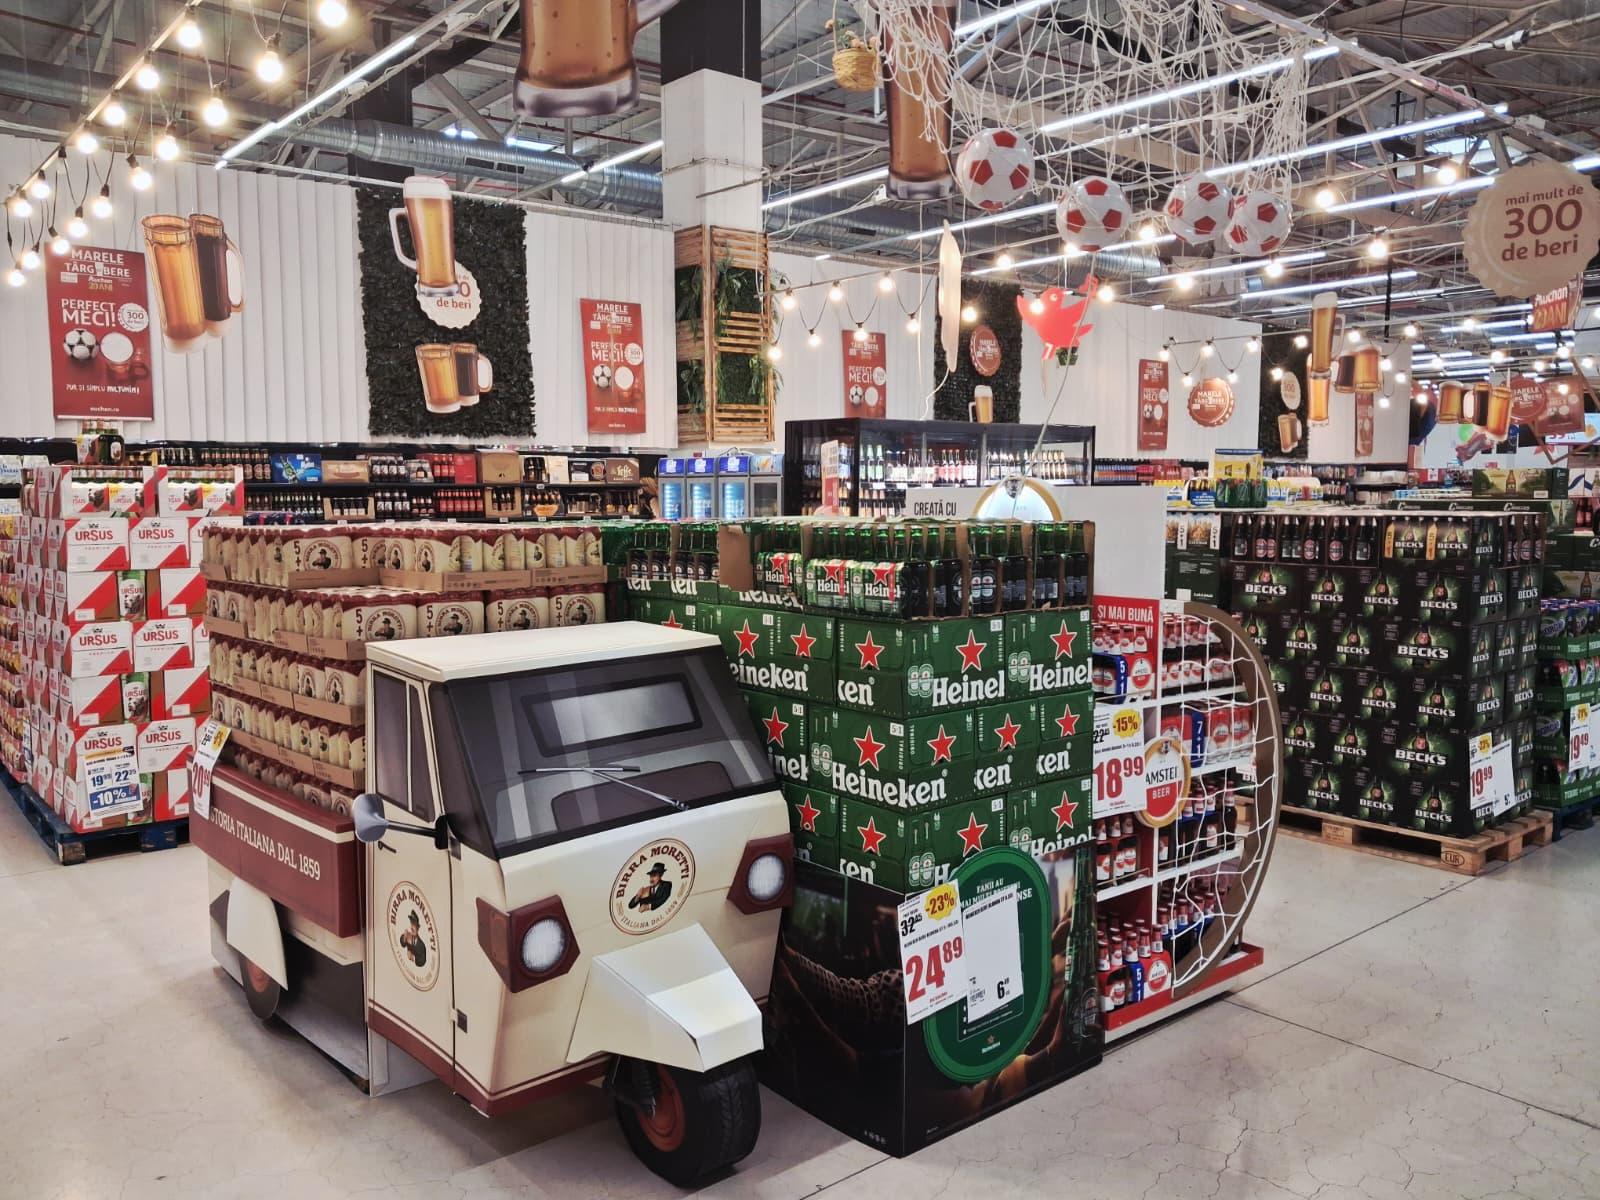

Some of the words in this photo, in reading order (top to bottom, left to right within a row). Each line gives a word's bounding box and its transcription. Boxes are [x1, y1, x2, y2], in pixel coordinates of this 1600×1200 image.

[1505, 191, 1530, 206] mai
[1533, 187, 1564, 203] mult
[1567, 184, 1584, 196] de
[1503, 198, 1583, 240] 300
[1501, 241, 1529, 262] de
[1534, 233, 1579, 258] beri
[71, 249, 124, 264] MARELE
[103, 266, 131, 277] BERE
[1534, 286, 1569, 306] Auchan
[61, 298, 116, 312] PERFECT
[436, 297, 450, 308] de
[451, 298, 472, 310] beri
[596, 303, 629, 314] MARELE
[62, 309, 116, 327] MECI!
[127, 311, 144, 320] 300
[591, 341, 624, 351] PERFCT
[945, 502, 957, 516] CU
[75, 529, 114, 541] URSUS
[138, 528, 175, 540] URSUS
[1244, 582, 1287, 596] BECK'S
[1517, 586, 1538, 600] BECK'S
[1310, 592, 1344, 603] BECK'S
[1364, 595, 1399, 606] BECK'S
[1479, 591, 1503, 606] BECK'S
[1420, 599, 1458, 611] BECK'S
[1108, 605, 1126, 621] MAI
[1127, 606, 1154, 624] BUNĂ
[79, 633, 118, 647] URSUS
[143, 629, 179, 643] URSUS
[1286, 640, 1318, 651] BECK'S
[1336, 644, 1370, 656] BECK'S
[1397, 644, 1449, 659] BECK'S
[1472, 652, 1490, 663] BECK'S
[729, 657, 809, 693] eineken
[1310, 691, 1342, 703] BECK'S
[1514, 689, 1534, 703] BECK'S
[1362, 698, 1397, 709] BECK'S
[1476, 698, 1500, 713] BECK'S
[1418, 705, 1456, 717] BECK'S
[1112, 714, 1138, 733] -15%
[84, 736, 122, 750] URSUS
[145, 730, 182, 744] URSUS
[1284, 737, 1316, 749] BECK'S
[1333, 744, 1367, 756] BECK'S
[1570, 734, 1580, 761] 19
[1394, 749, 1447, 766] BECK'S
[92, 774, 104, 787] 19
[115, 769, 129, 782] 22
[192, 761, 204, 798] 20
[1093, 758, 1123, 801] 18
[1123, 756, 1144, 778] 99
[1471, 767, 1484, 798] 19
[832, 760, 947, 809] Heineken
[93, 789, 127, 806] -10%
[1152, 786, 1170, 799] BEER
[1307, 789, 1340, 801] BECK'S
[1359, 798, 1394, 811] BECK'S
[1414, 808, 1453, 823] BECK'S
[236, 820, 276, 859] ITALIANA
[277, 842, 298, 869] DAL
[298, 853, 321, 881] 1859
[616, 854, 648, 899] BIRRA
[650, 845, 690, 880] MORETTI
[925, 891, 955, 916] -23%
[390, 889, 408, 926] BIRRA
[408, 889, 437, 953] MORETTI
[900, 915, 916, 937] 32
[905, 943, 946, 1003] 24
[943, 935, 964, 965] 89
[996, 980, 1005, 1000] 6
